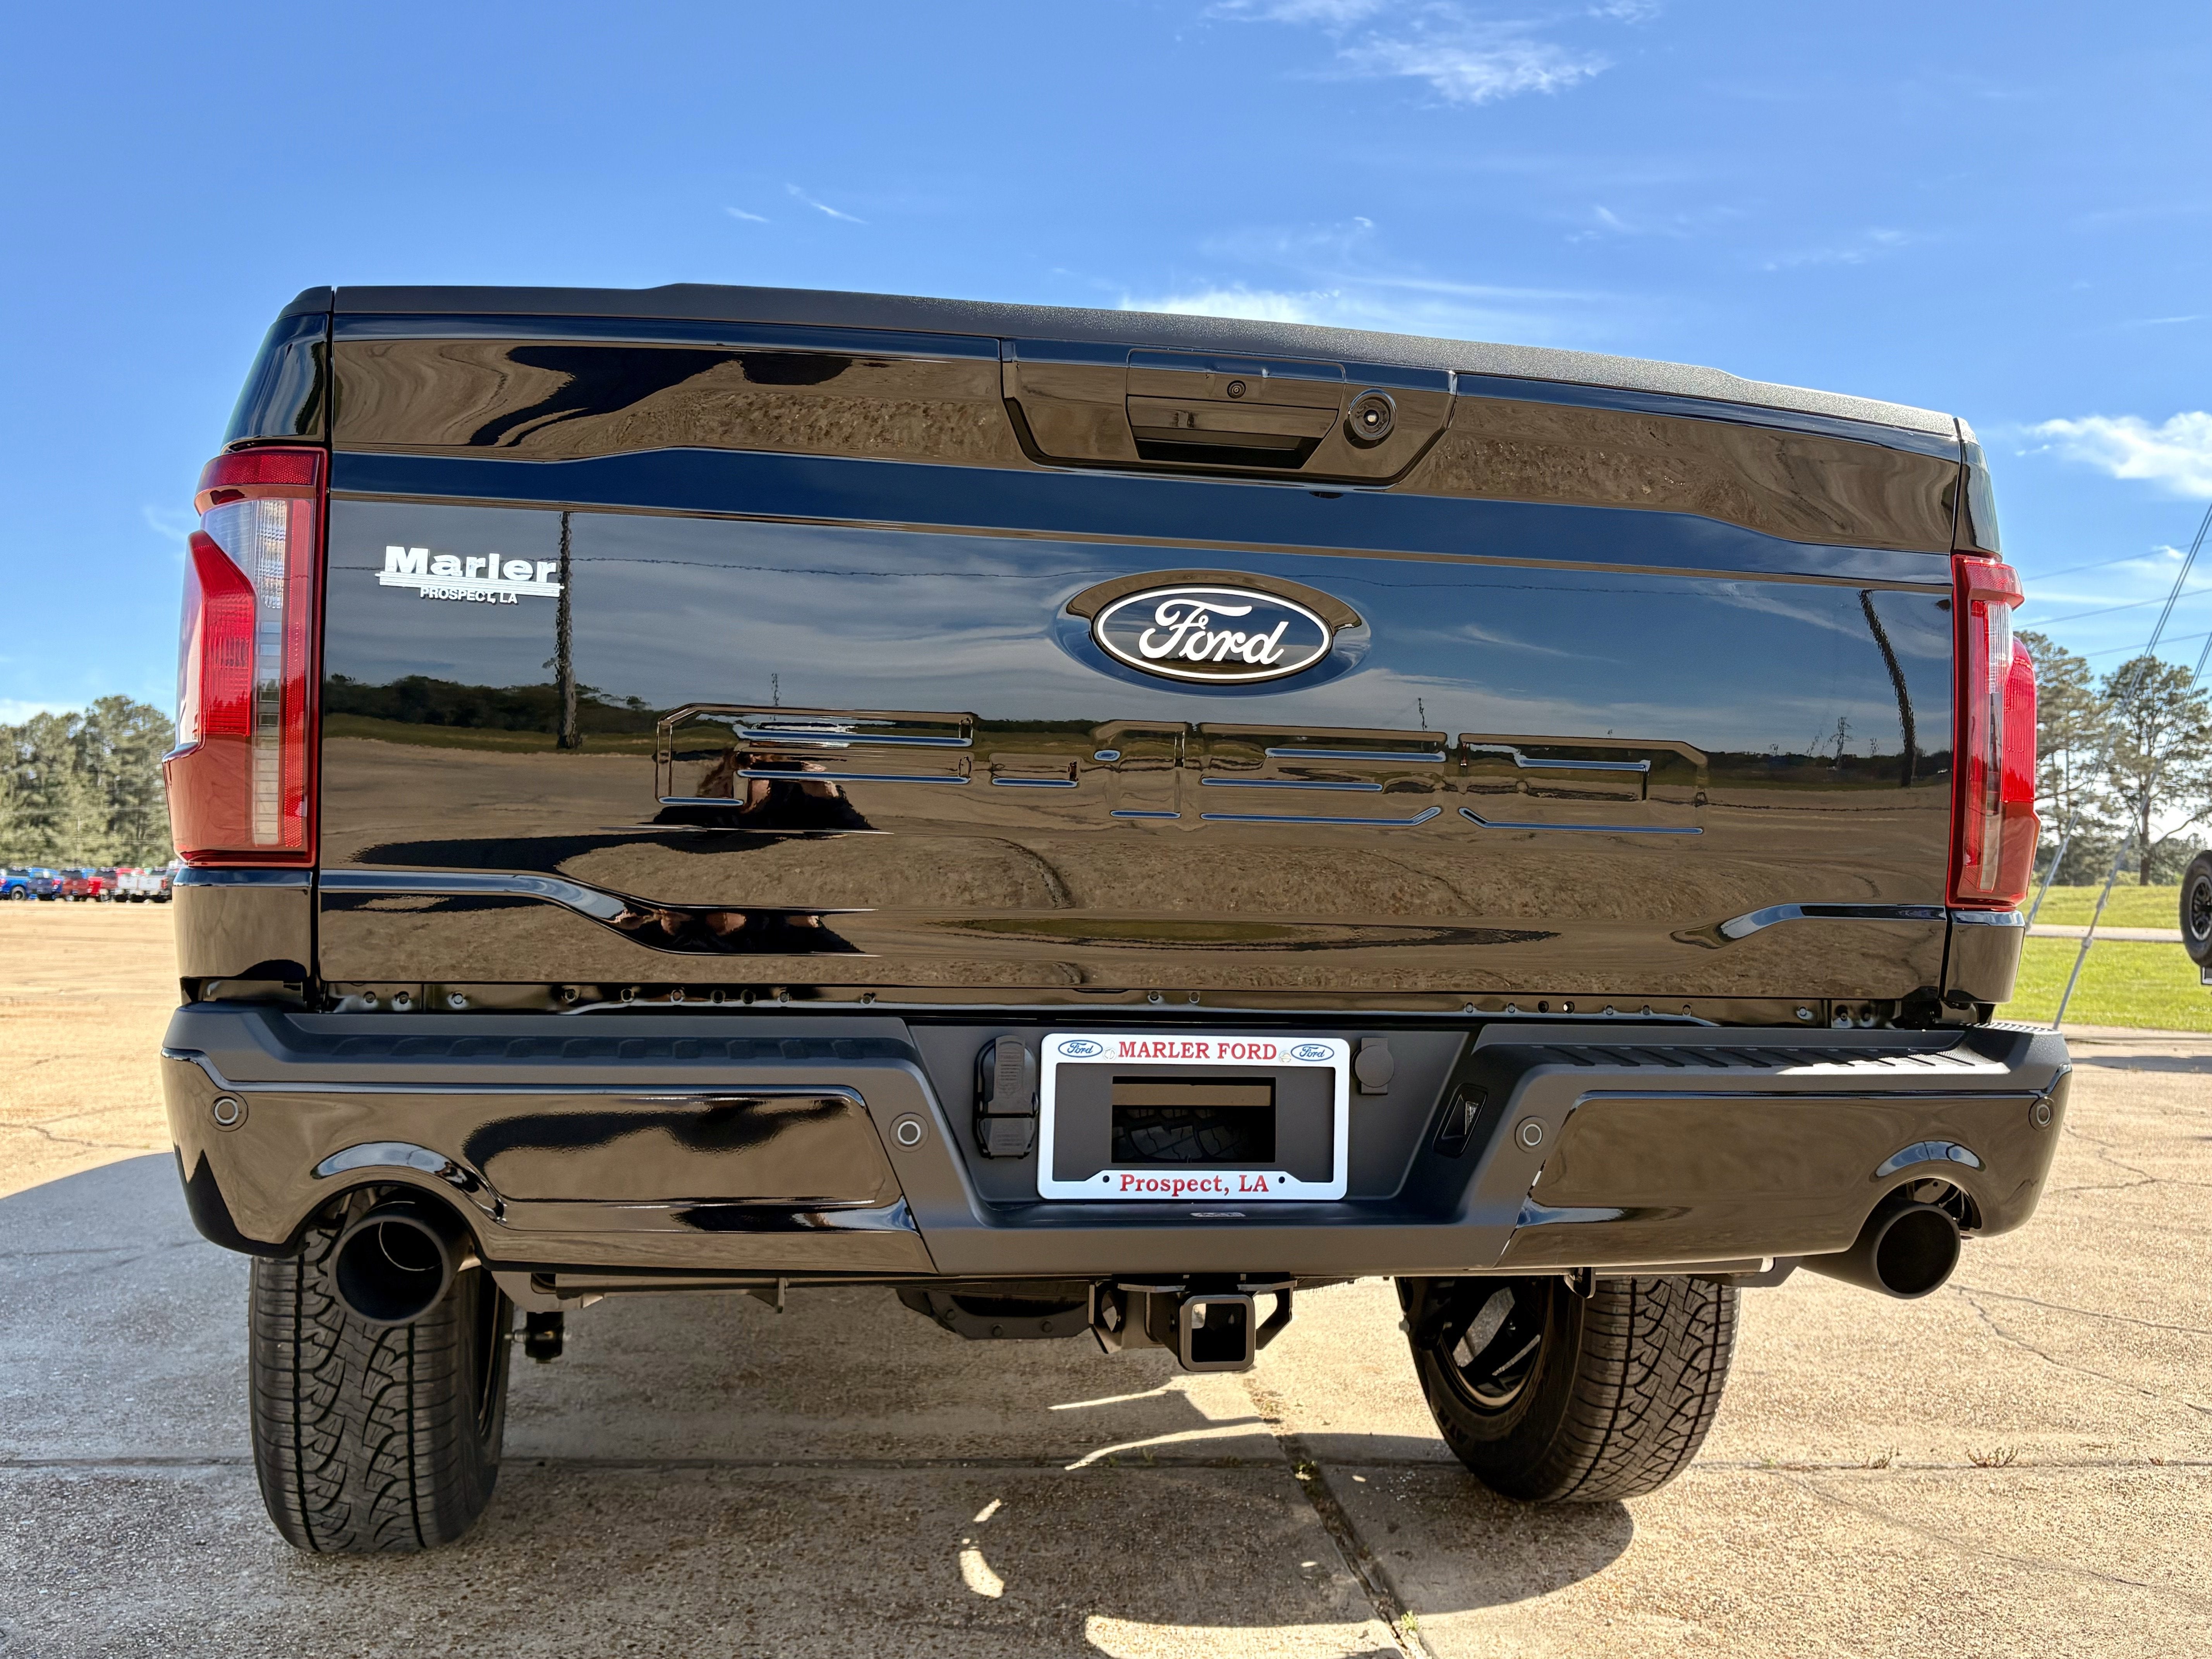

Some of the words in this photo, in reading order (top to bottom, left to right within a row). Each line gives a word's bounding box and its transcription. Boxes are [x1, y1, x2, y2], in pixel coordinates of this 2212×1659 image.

[385, 546, 557, 583] Marler
[420, 587, 496, 604] PROSPECT,
[500, 592, 518, 604] LA
[1139, 599, 1289, 665] Ford
[1067, 1042, 1093, 1054] Ford
[1118, 1041, 1210, 1059] MARLER
[1217, 1042, 1277, 1060] FORD
[1299, 1046, 1325, 1058] Ford
[1120, 1174, 1229, 1197] Prospect,
[1239, 1175, 1269, 1192] LA
